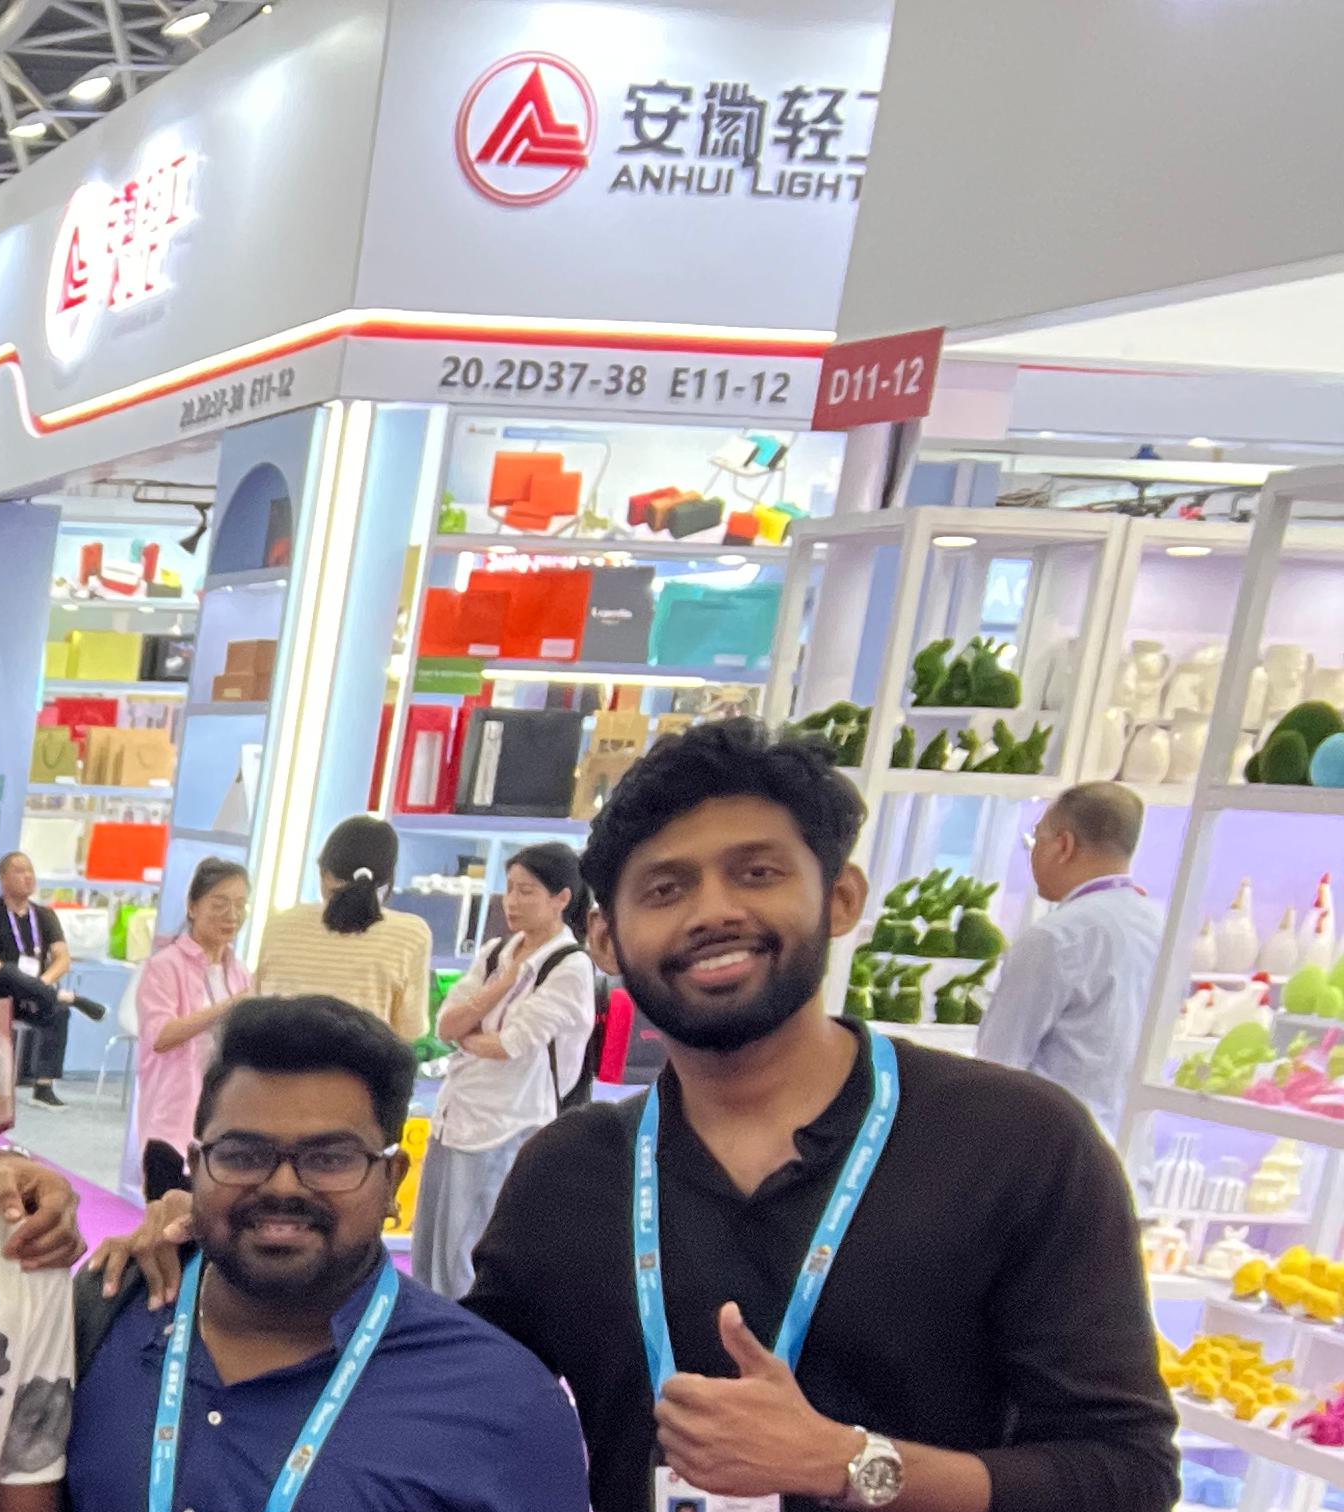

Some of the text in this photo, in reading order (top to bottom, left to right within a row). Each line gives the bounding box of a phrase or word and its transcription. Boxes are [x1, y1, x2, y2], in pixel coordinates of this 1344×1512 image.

[608, 160, 863, 202] ANHUI LIGHT
[439, 356, 791, 404] 20.2D37-38 E11-12
[827, 356, 926, 406] D11-12
